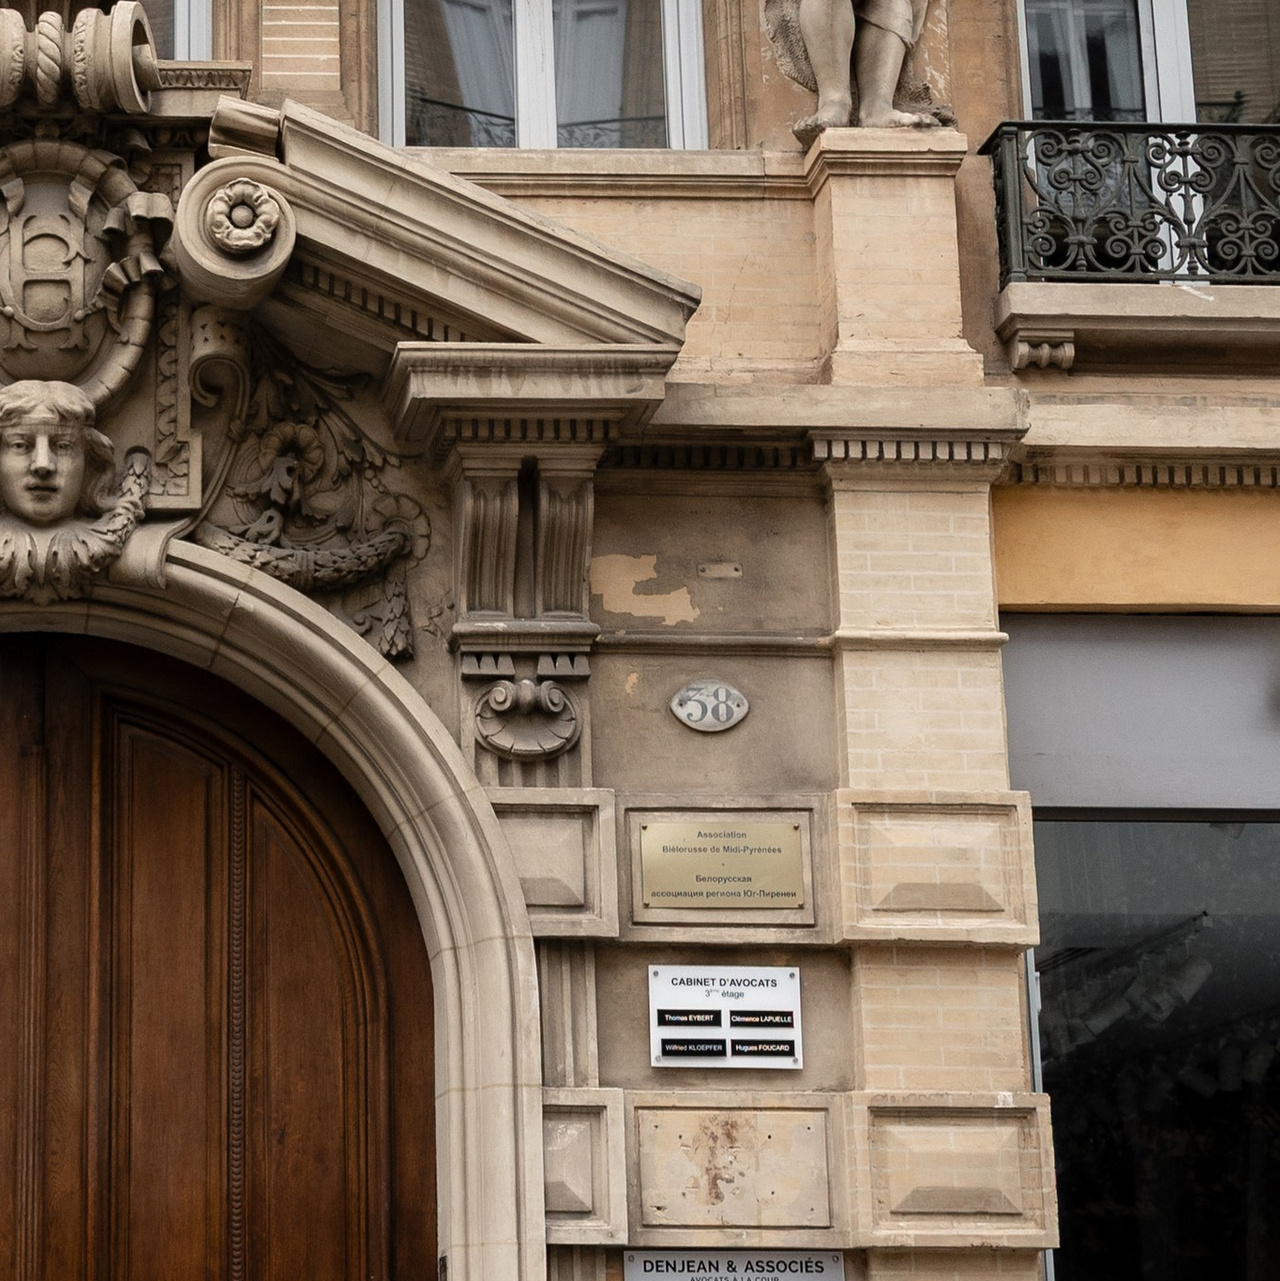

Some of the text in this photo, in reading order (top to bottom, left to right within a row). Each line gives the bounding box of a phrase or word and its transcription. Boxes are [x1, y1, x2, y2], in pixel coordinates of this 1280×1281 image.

[686, 687, 734, 723] 38
[697, 831, 747, 839] Association
[662, 845, 782, 855] Biélorusse de Midi-Pyrénées
[695, 875, 752, 884] Белорусская
[651, 891, 704, 899] ассоциация
[706, 891, 741, 901] региона
[671, 977, 778, 988] CABINET D'AVOCATS
[721, 990, 745, 1000] étage
[665, 1014, 714, 1022] Thomas EYBERT
[735, 1044, 758, 1053] Hugues
[643, 1257, 825, 1274] DENJEAN & ASSOCIÉS
